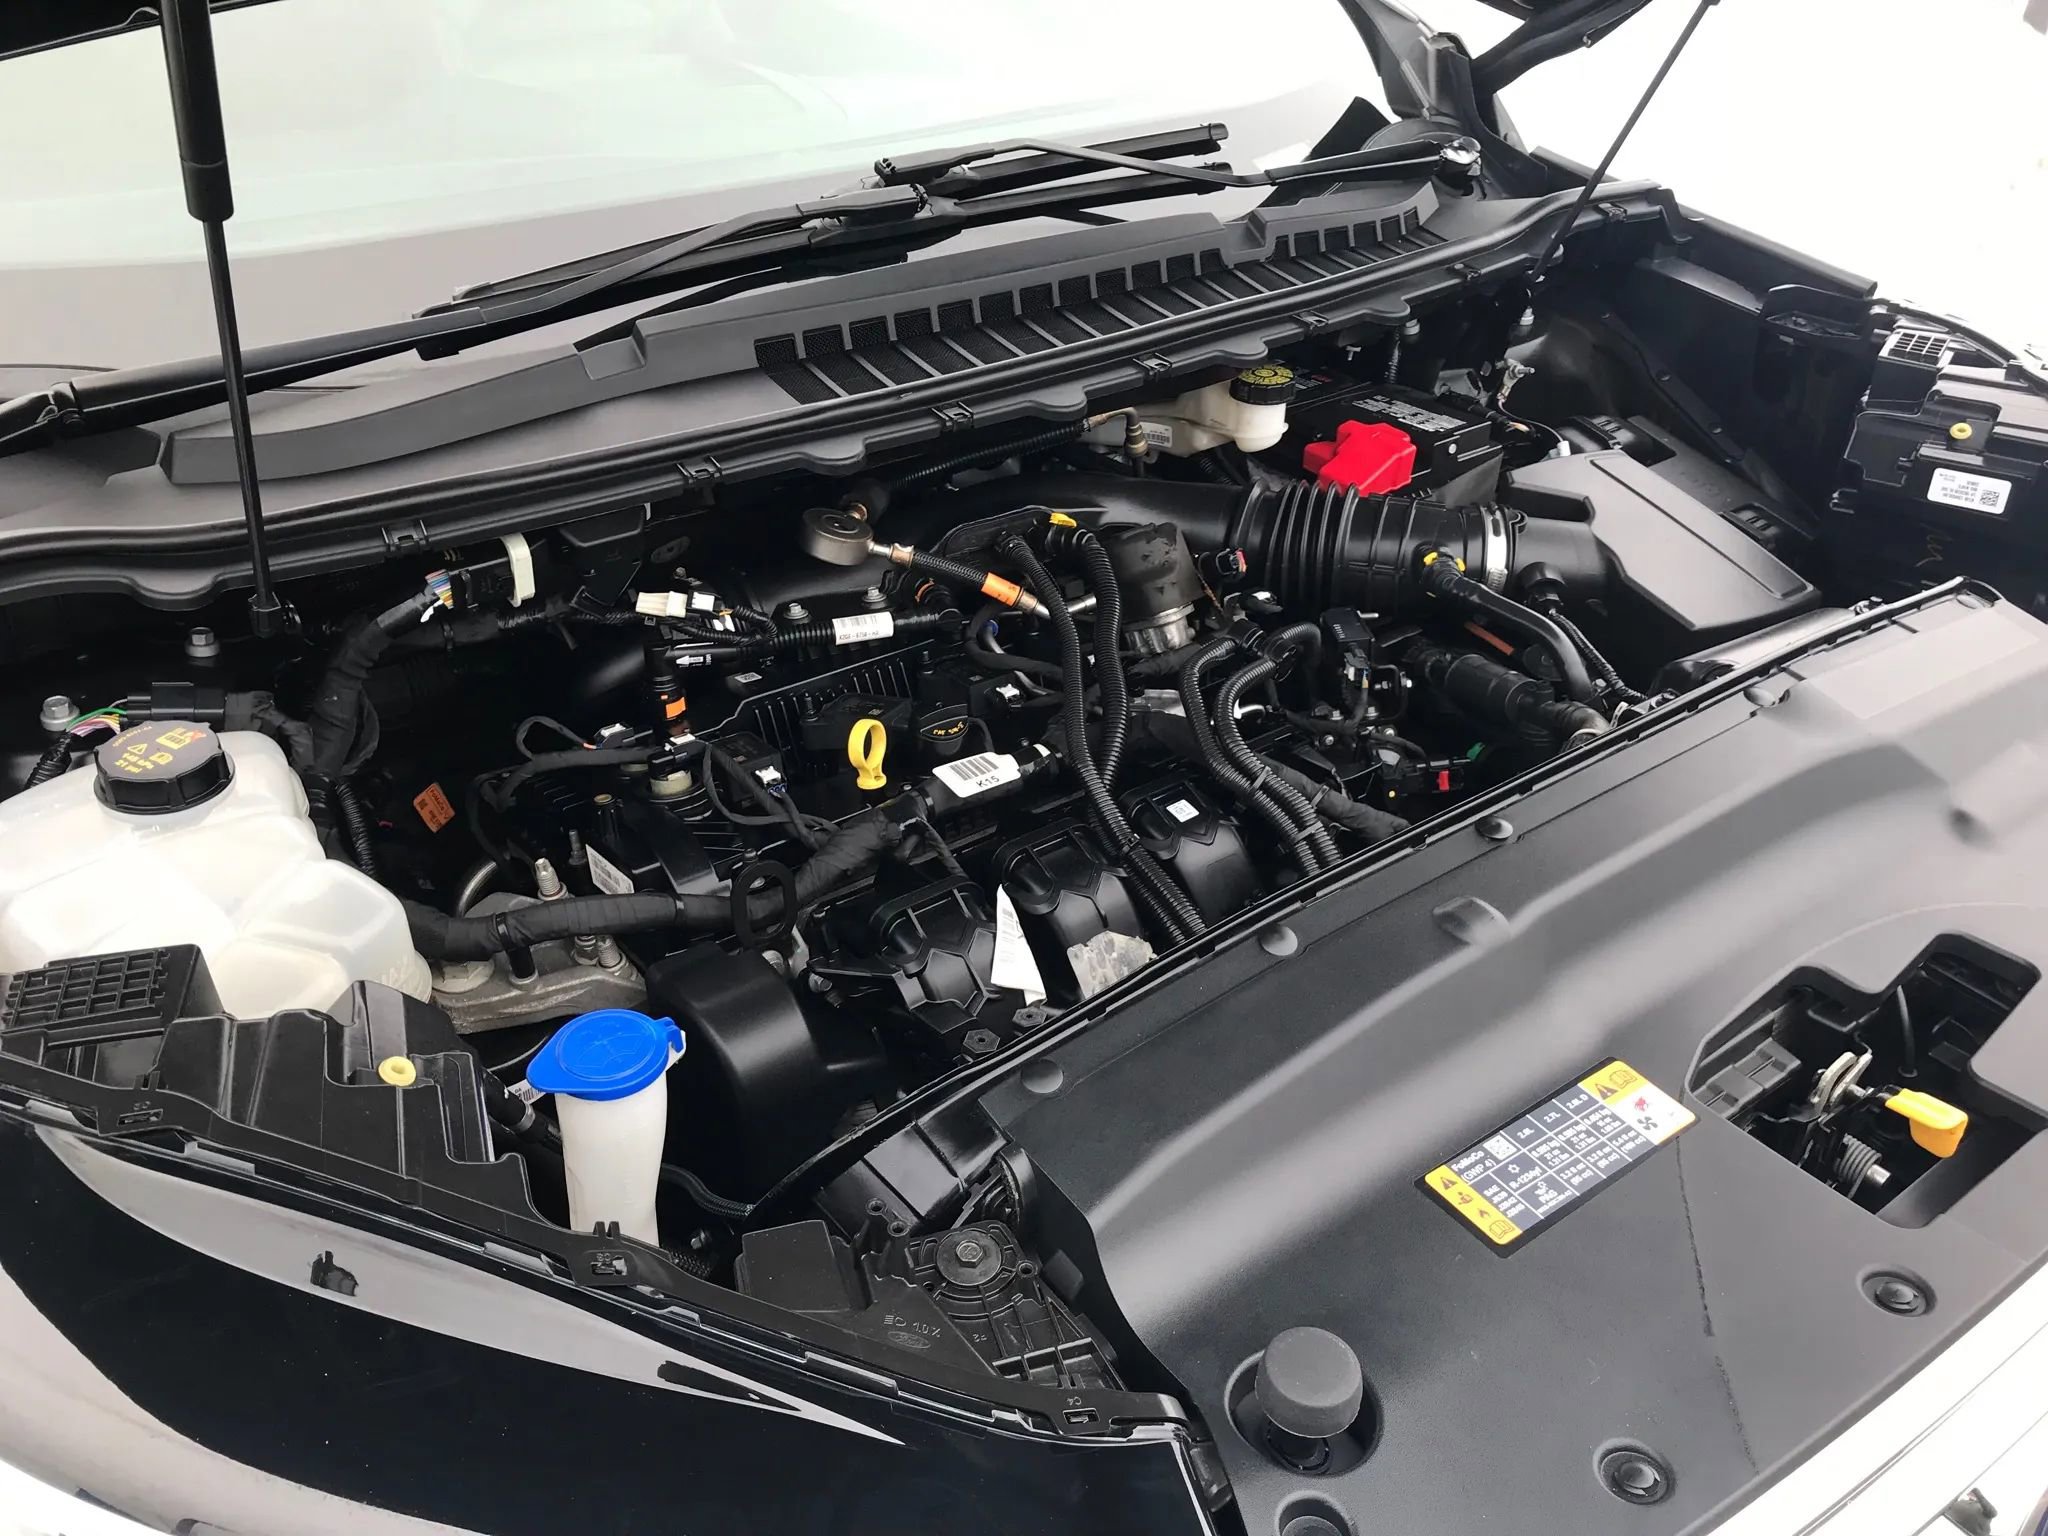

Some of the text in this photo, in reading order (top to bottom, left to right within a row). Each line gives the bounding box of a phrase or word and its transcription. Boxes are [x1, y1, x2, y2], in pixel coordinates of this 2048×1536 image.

[976, 776, 1000, 787] K15
[1451, 1151, 1484, 1171] FoMoCo
[1461, 1158, 1496, 1182] (GWP 4)
